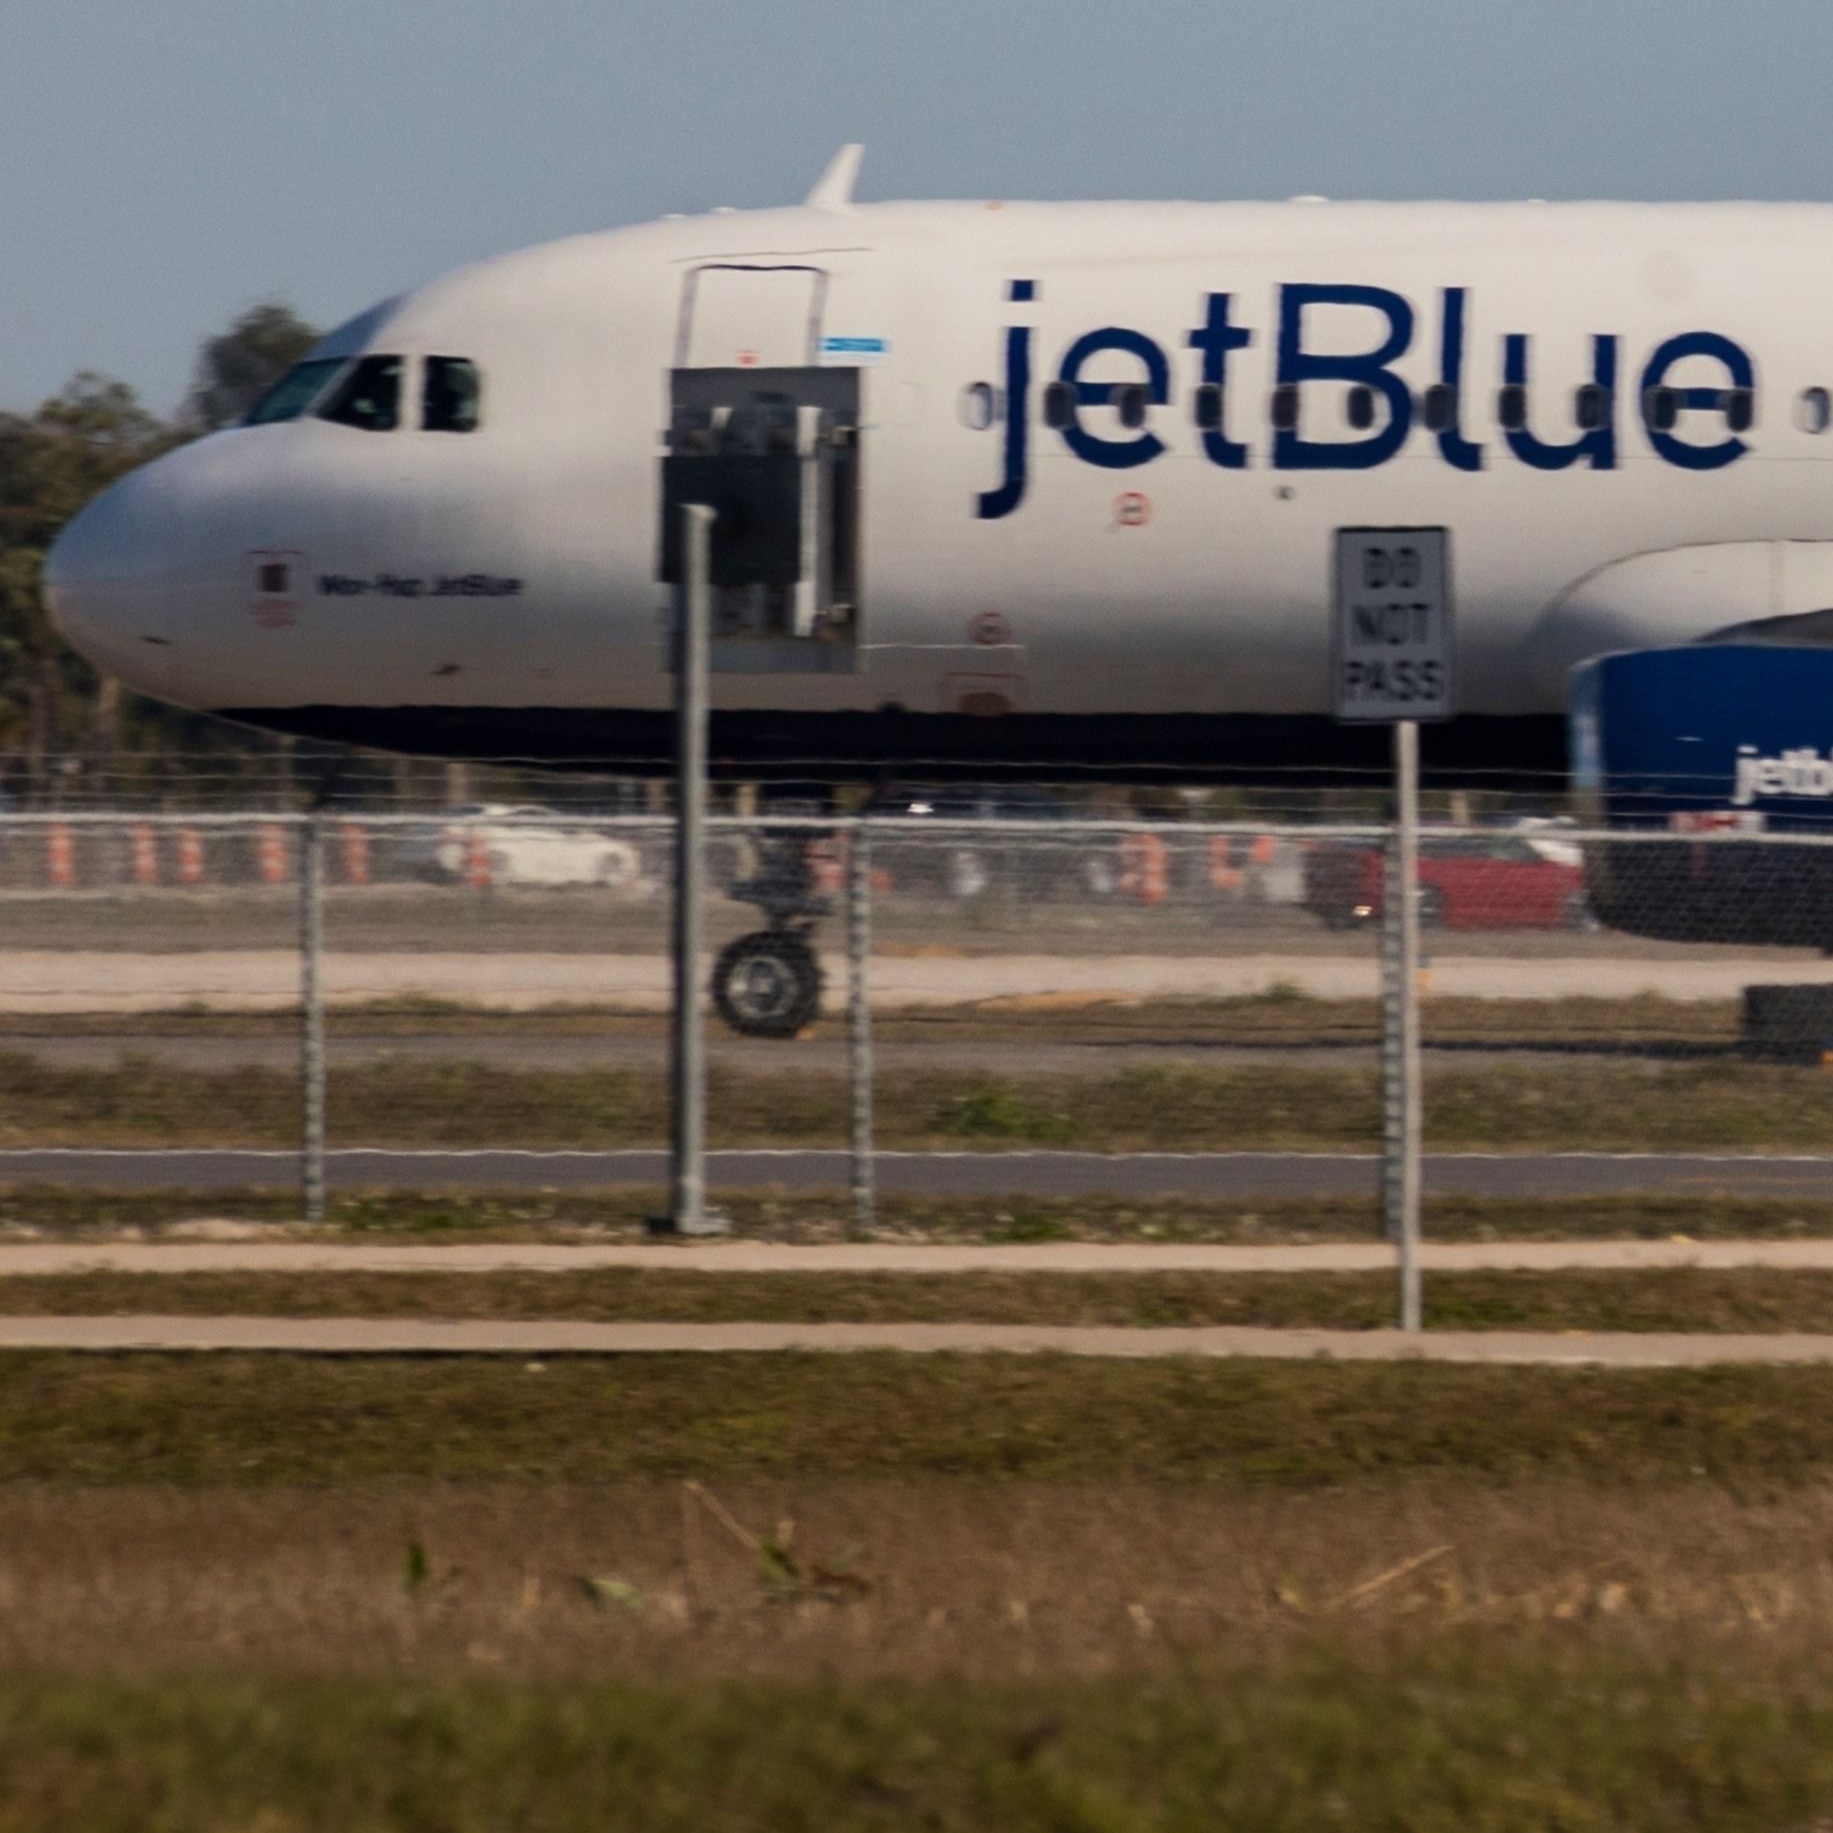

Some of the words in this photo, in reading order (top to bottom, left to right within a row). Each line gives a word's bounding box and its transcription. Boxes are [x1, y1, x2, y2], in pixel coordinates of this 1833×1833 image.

[974, 279, 1757, 519] jetBlue
[1361, 546, 1422, 588] DO
[1353, 602, 1431, 646] NOT
[1345, 660, 1442, 702] PASS
